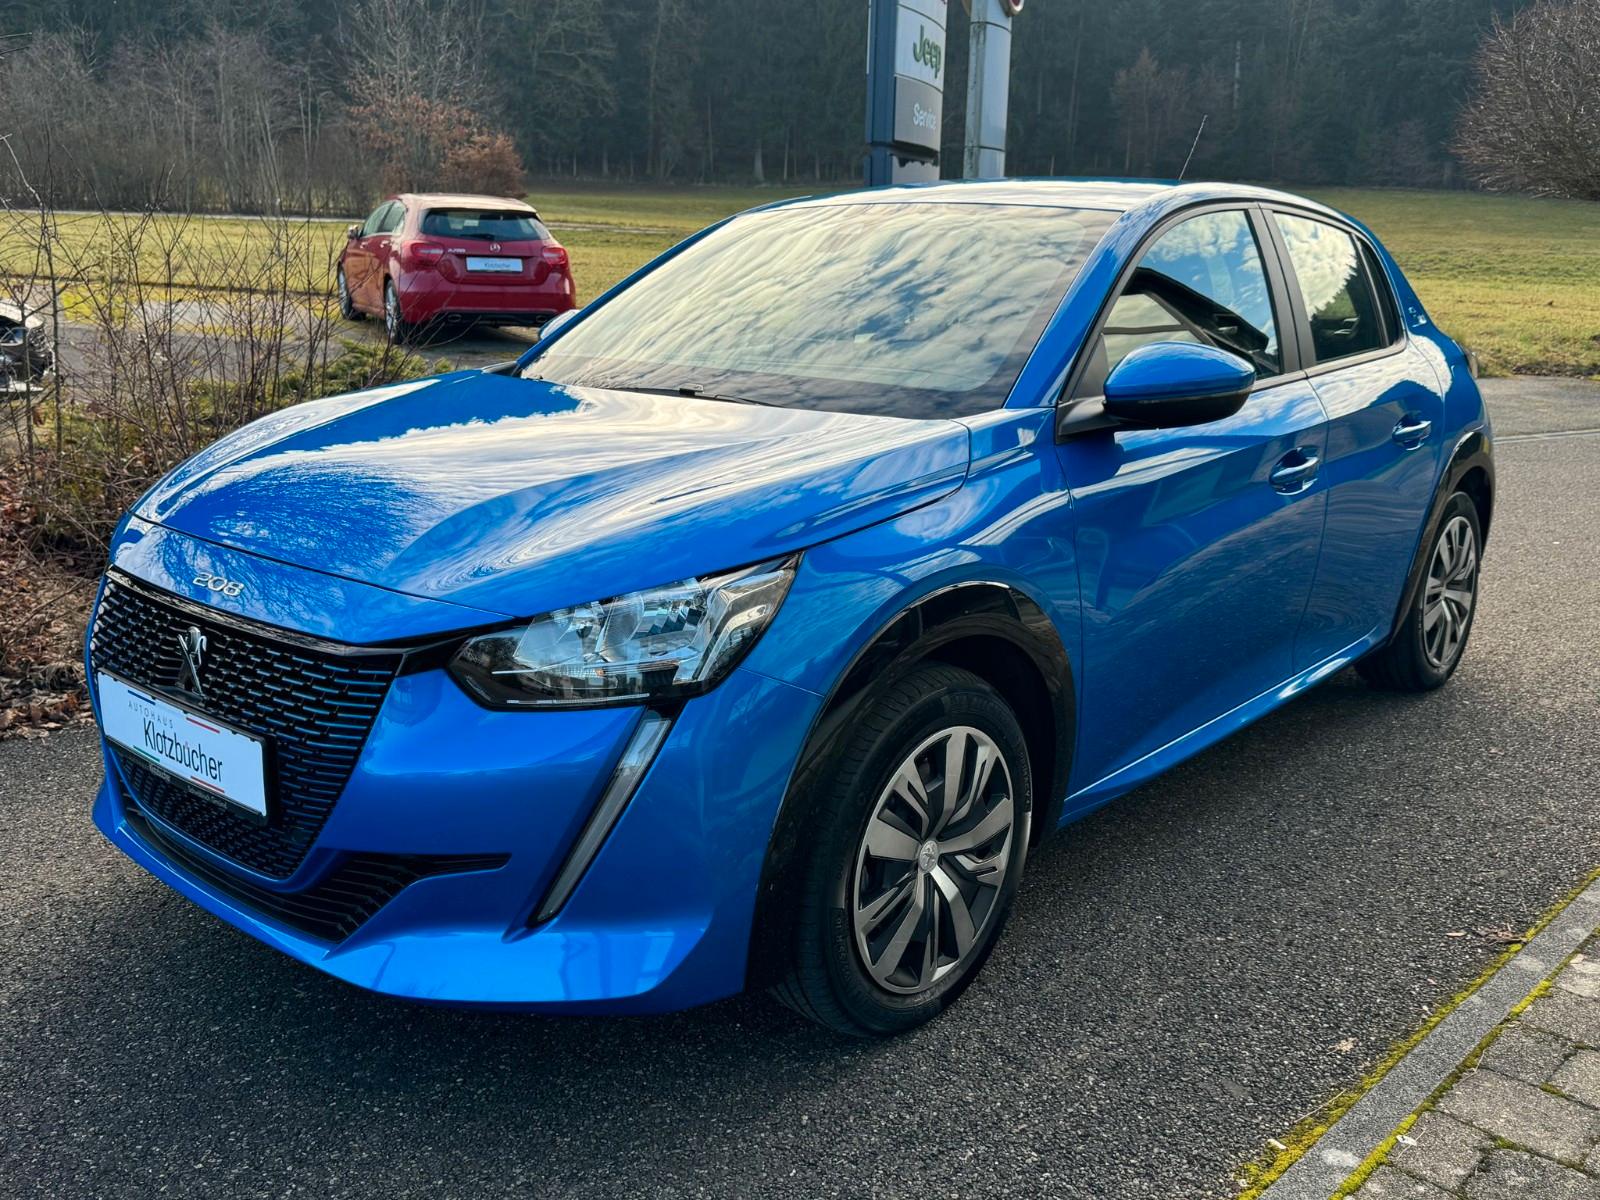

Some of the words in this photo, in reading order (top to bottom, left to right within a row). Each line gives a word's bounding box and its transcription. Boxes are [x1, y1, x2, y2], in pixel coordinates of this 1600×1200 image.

[913, 24, 942, 79] Jeep
[193, 571, 244, 597] 208
[128, 701, 174, 728] AUTOHAUS
[143, 718, 223, 783] Klotzbücher
